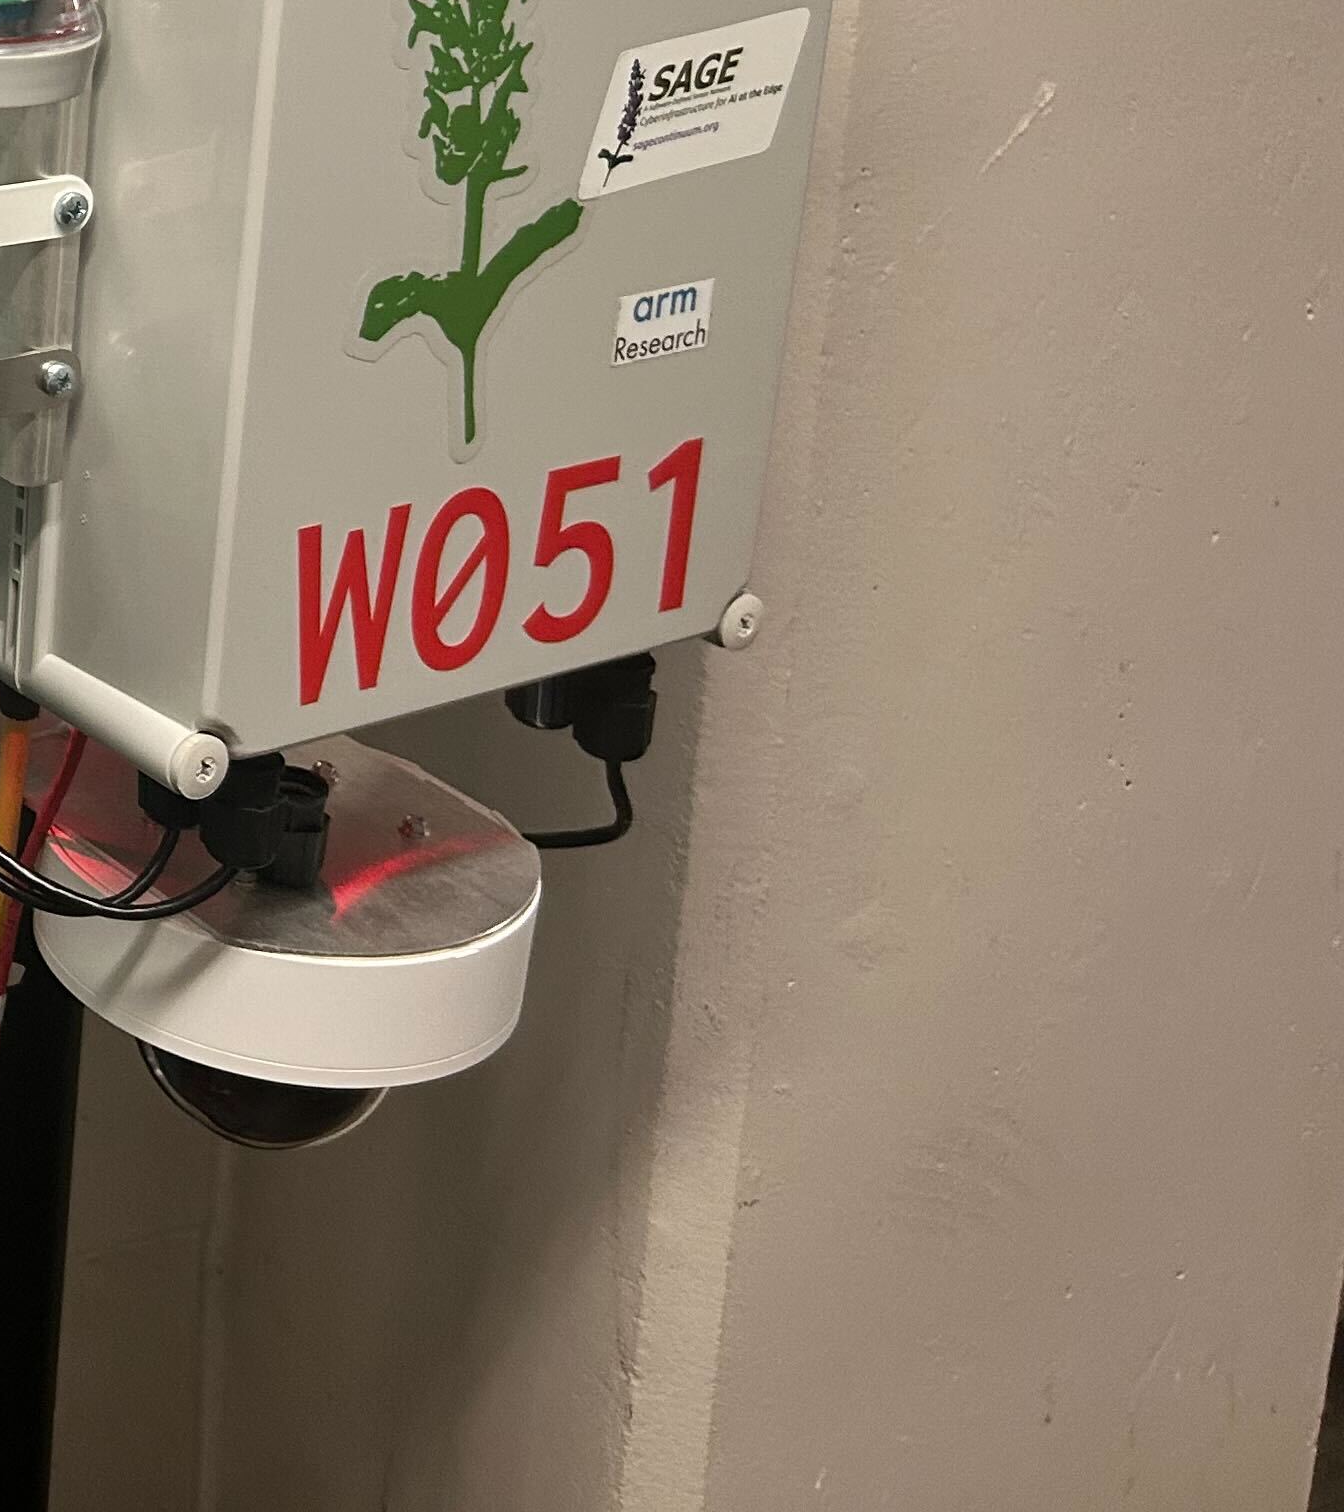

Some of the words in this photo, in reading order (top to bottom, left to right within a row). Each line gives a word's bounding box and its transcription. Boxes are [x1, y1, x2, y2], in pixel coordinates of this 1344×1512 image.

[647, 46, 744, 102] SAGE
[715, 96, 728, 110] for
[633, 286, 697, 323] arm
[613, 318, 706, 363] Research
[297, 436, 704, 707] W051
